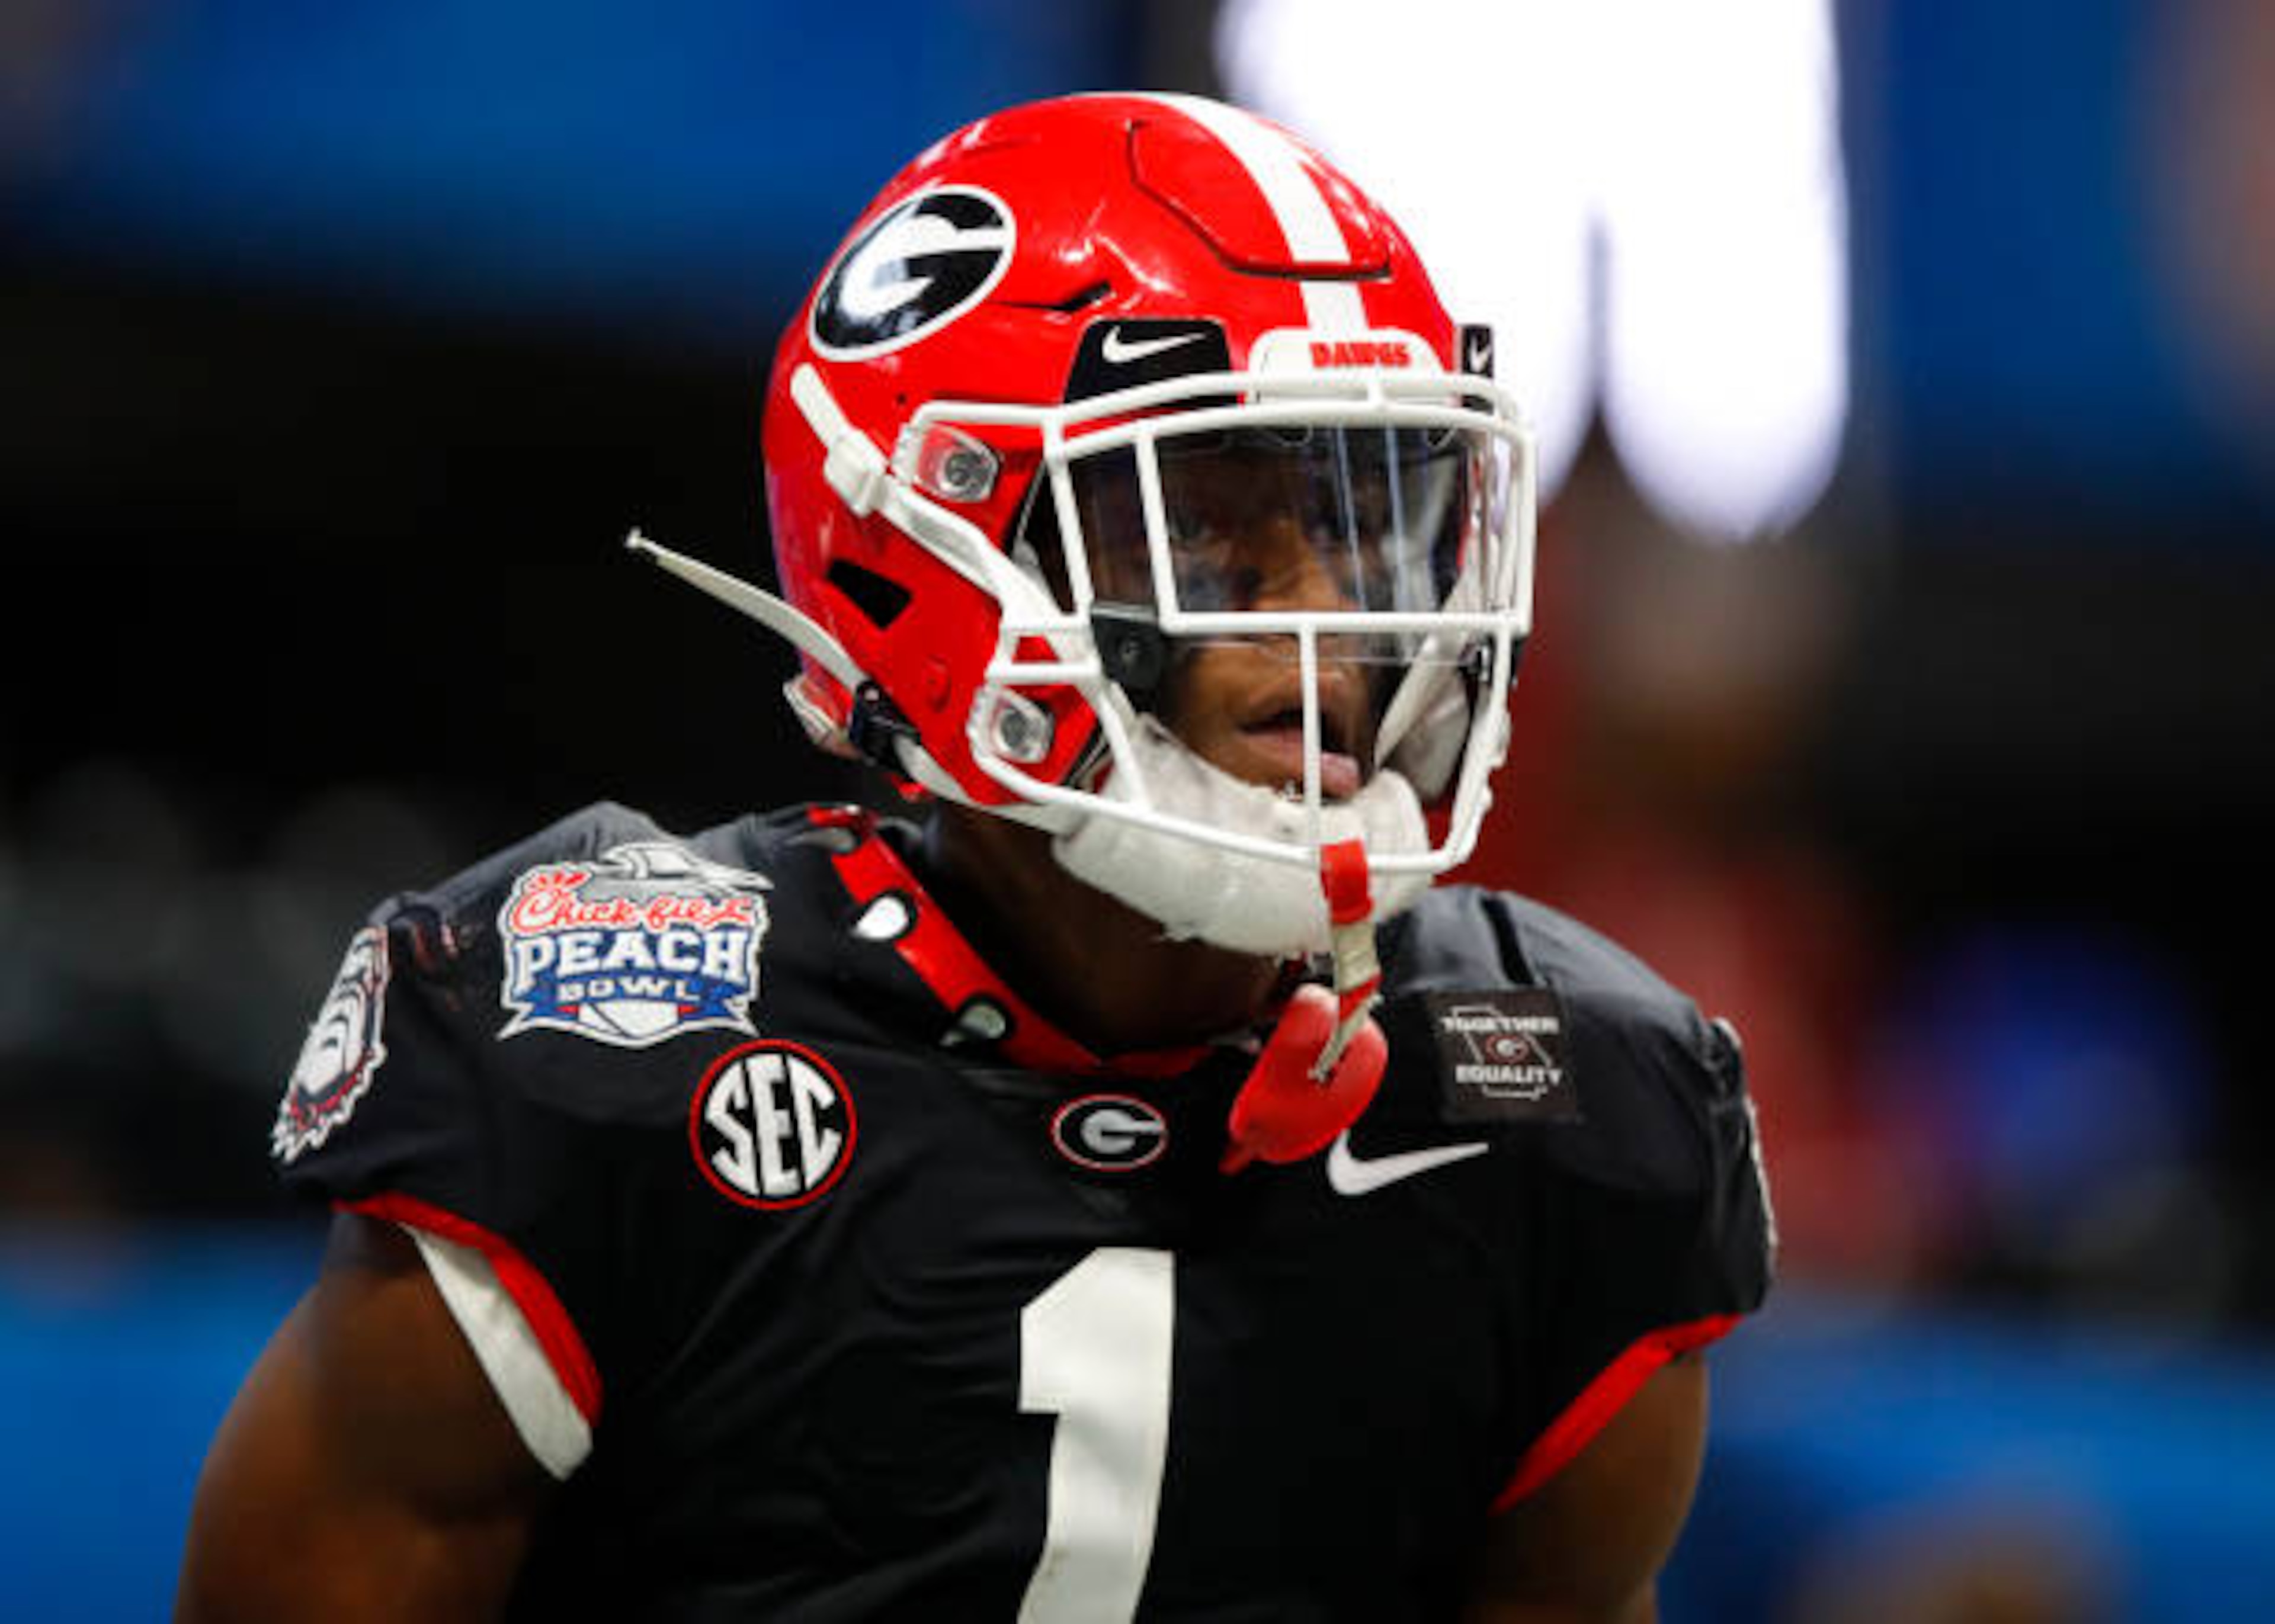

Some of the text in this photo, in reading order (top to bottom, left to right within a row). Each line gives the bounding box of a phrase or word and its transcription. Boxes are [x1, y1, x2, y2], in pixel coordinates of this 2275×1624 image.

[1309, 341, 1411, 368] DAWGS
[512, 930, 749, 1000] PEACH
[558, 977, 701, 1001] BOWL
[1440, 1016, 1559, 1034] TOGETHER
[1456, 1065, 1562, 1086] EQUALITY
[705, 1053, 842, 1195] SEC
[1018, 1246, 1175, 1624] 1
